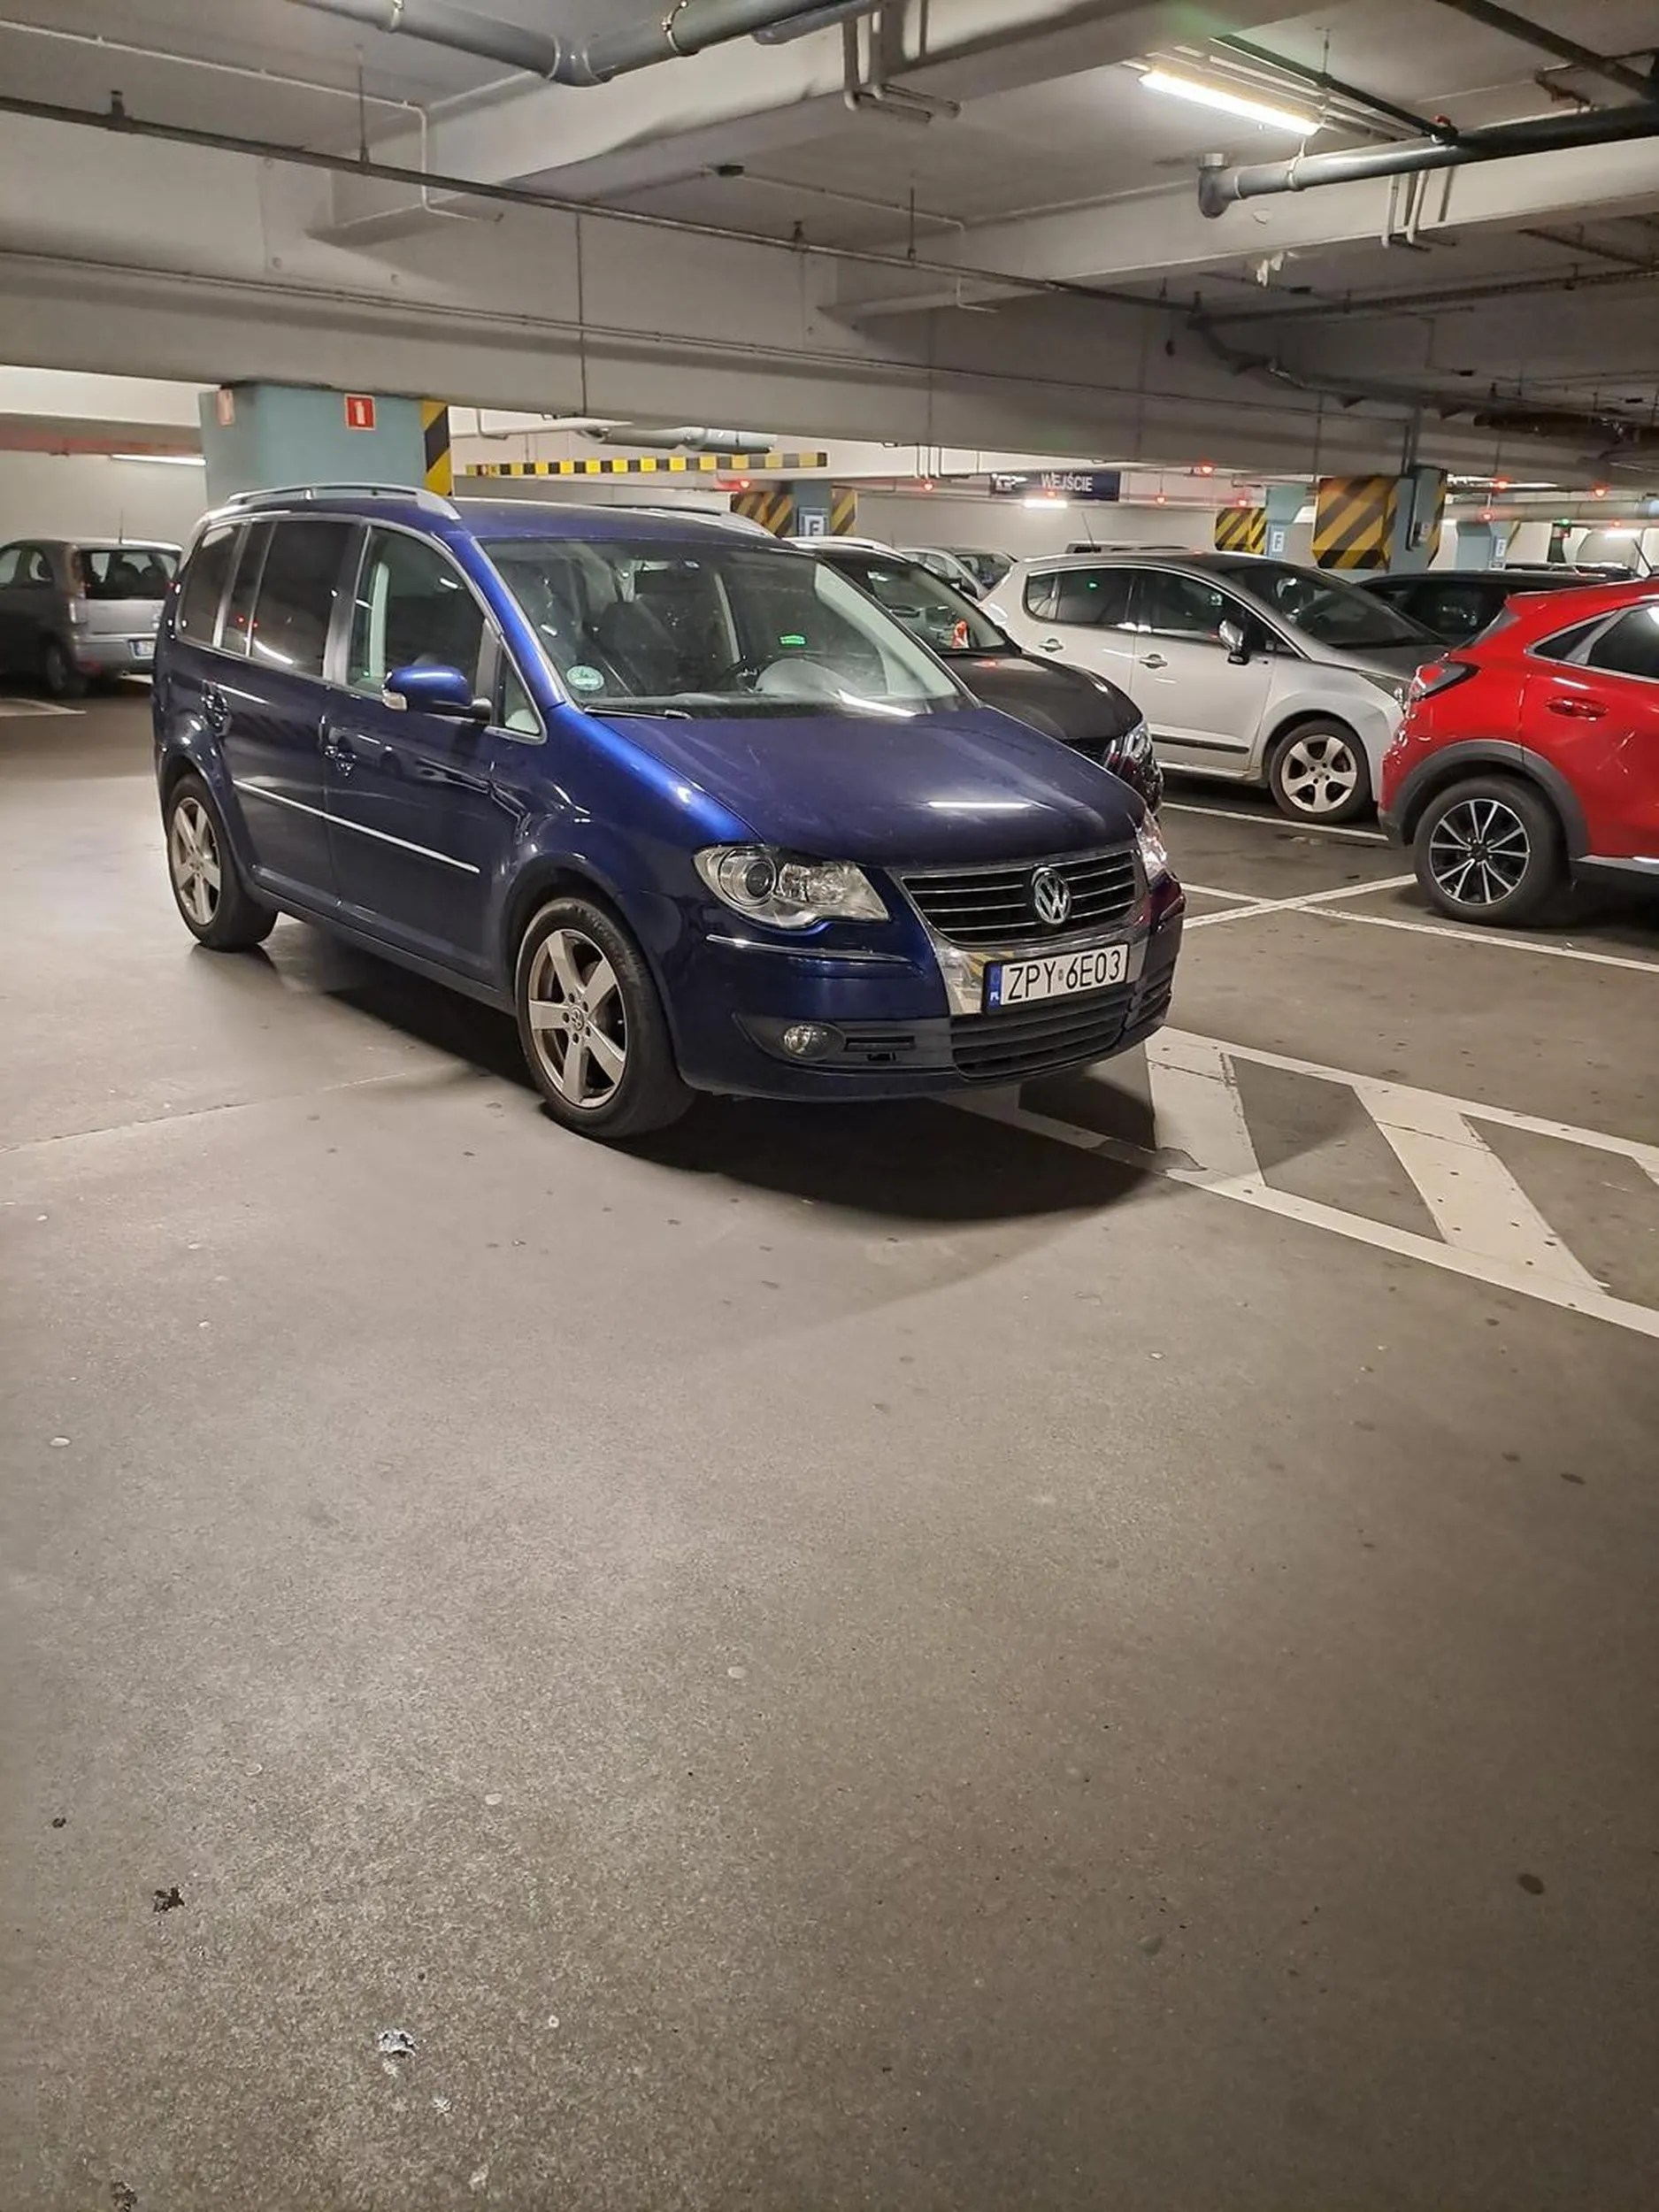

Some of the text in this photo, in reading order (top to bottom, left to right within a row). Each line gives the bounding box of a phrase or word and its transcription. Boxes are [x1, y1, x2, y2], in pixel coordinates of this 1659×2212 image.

[1041, 471, 1094, 492] WEJŚCIE
[1034, 871, 1071, 924] VW
[1008, 949, 1121, 1001] ZPY 6E03
